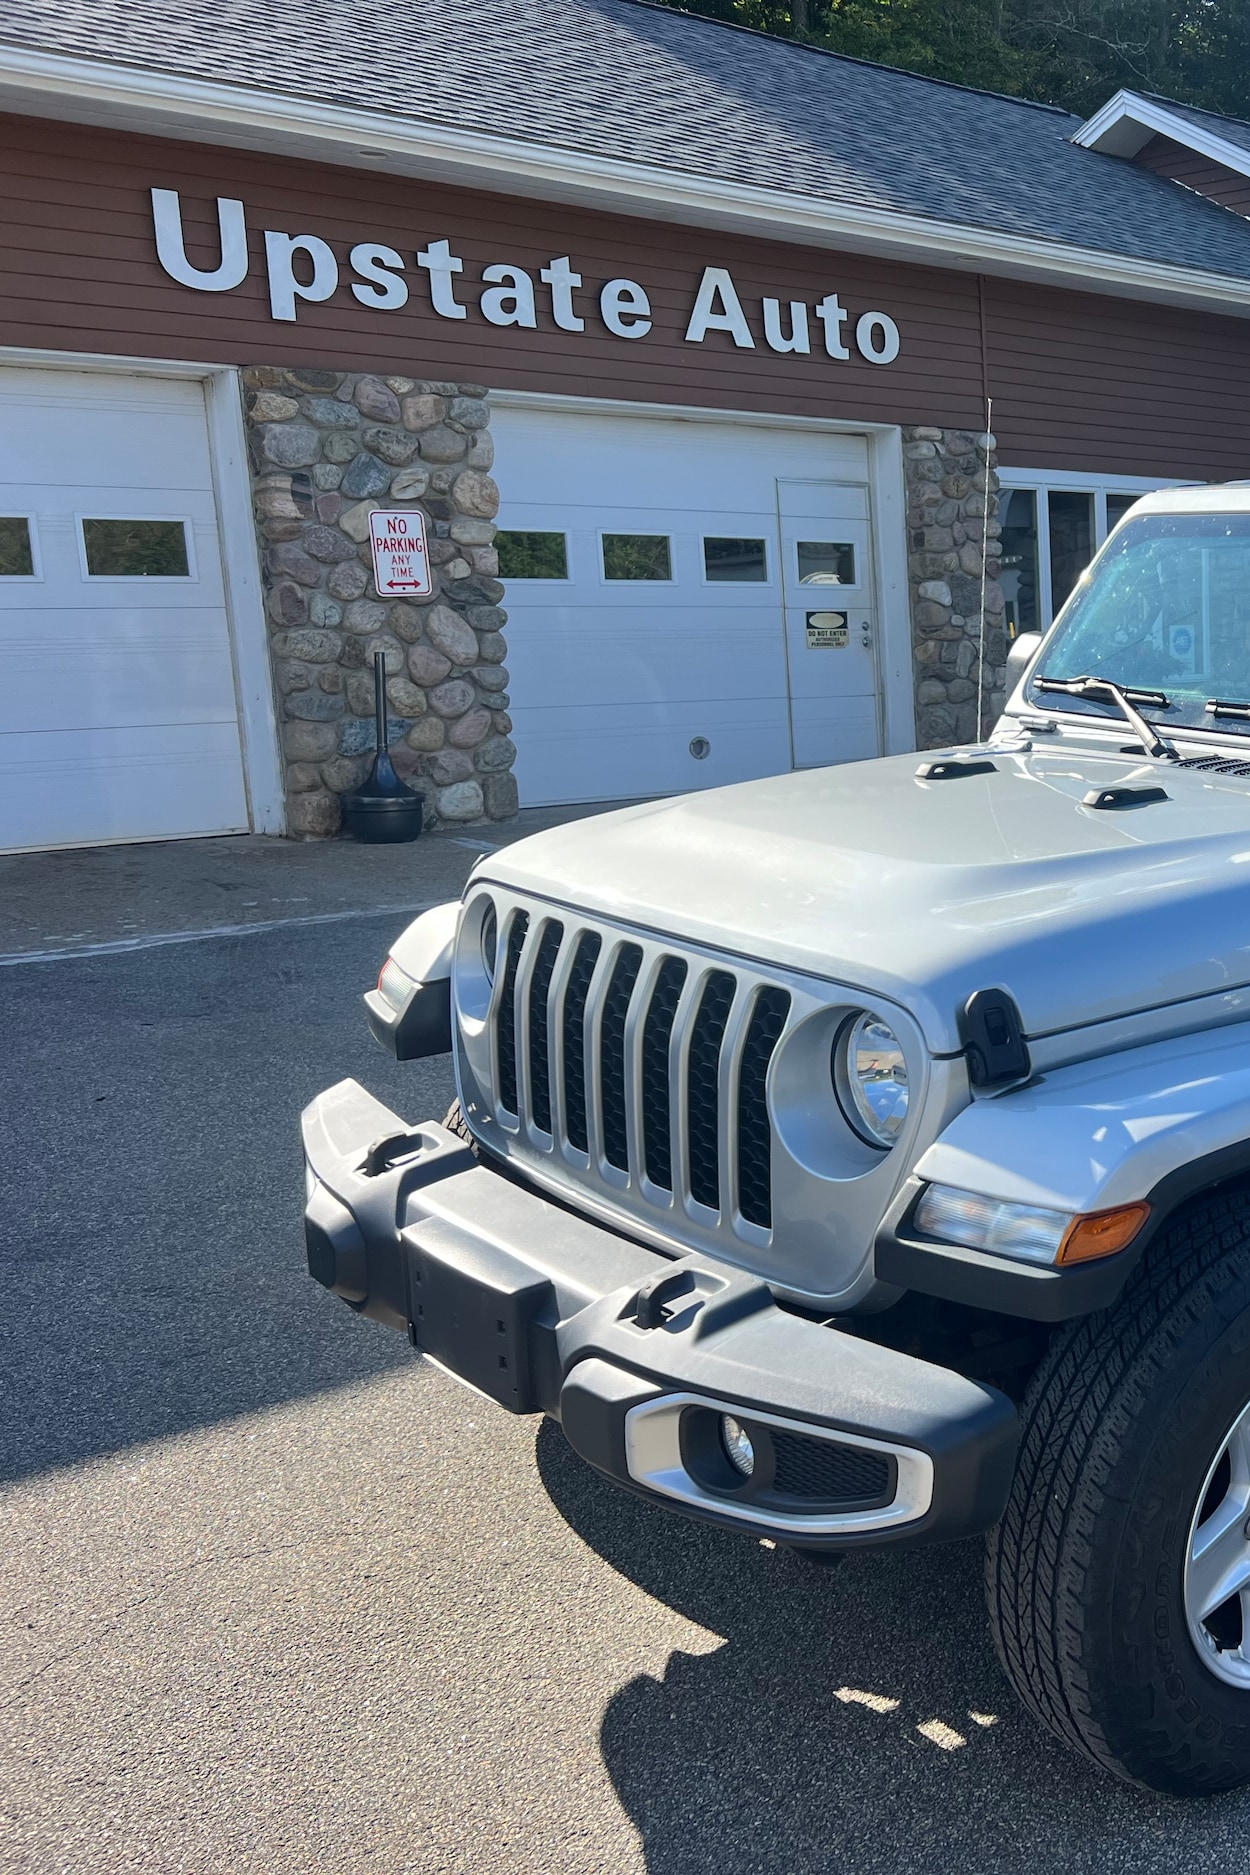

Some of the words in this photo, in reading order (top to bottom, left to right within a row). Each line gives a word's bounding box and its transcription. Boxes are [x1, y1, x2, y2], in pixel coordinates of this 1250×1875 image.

[150, 187, 653, 340] Upstate
[684, 267, 902, 365] Auto
[387, 519, 407, 534] NO
[376, 537, 423, 553] PARKING
[391, 555, 411, 565] ANY
[391, 567, 415, 578] TIME
